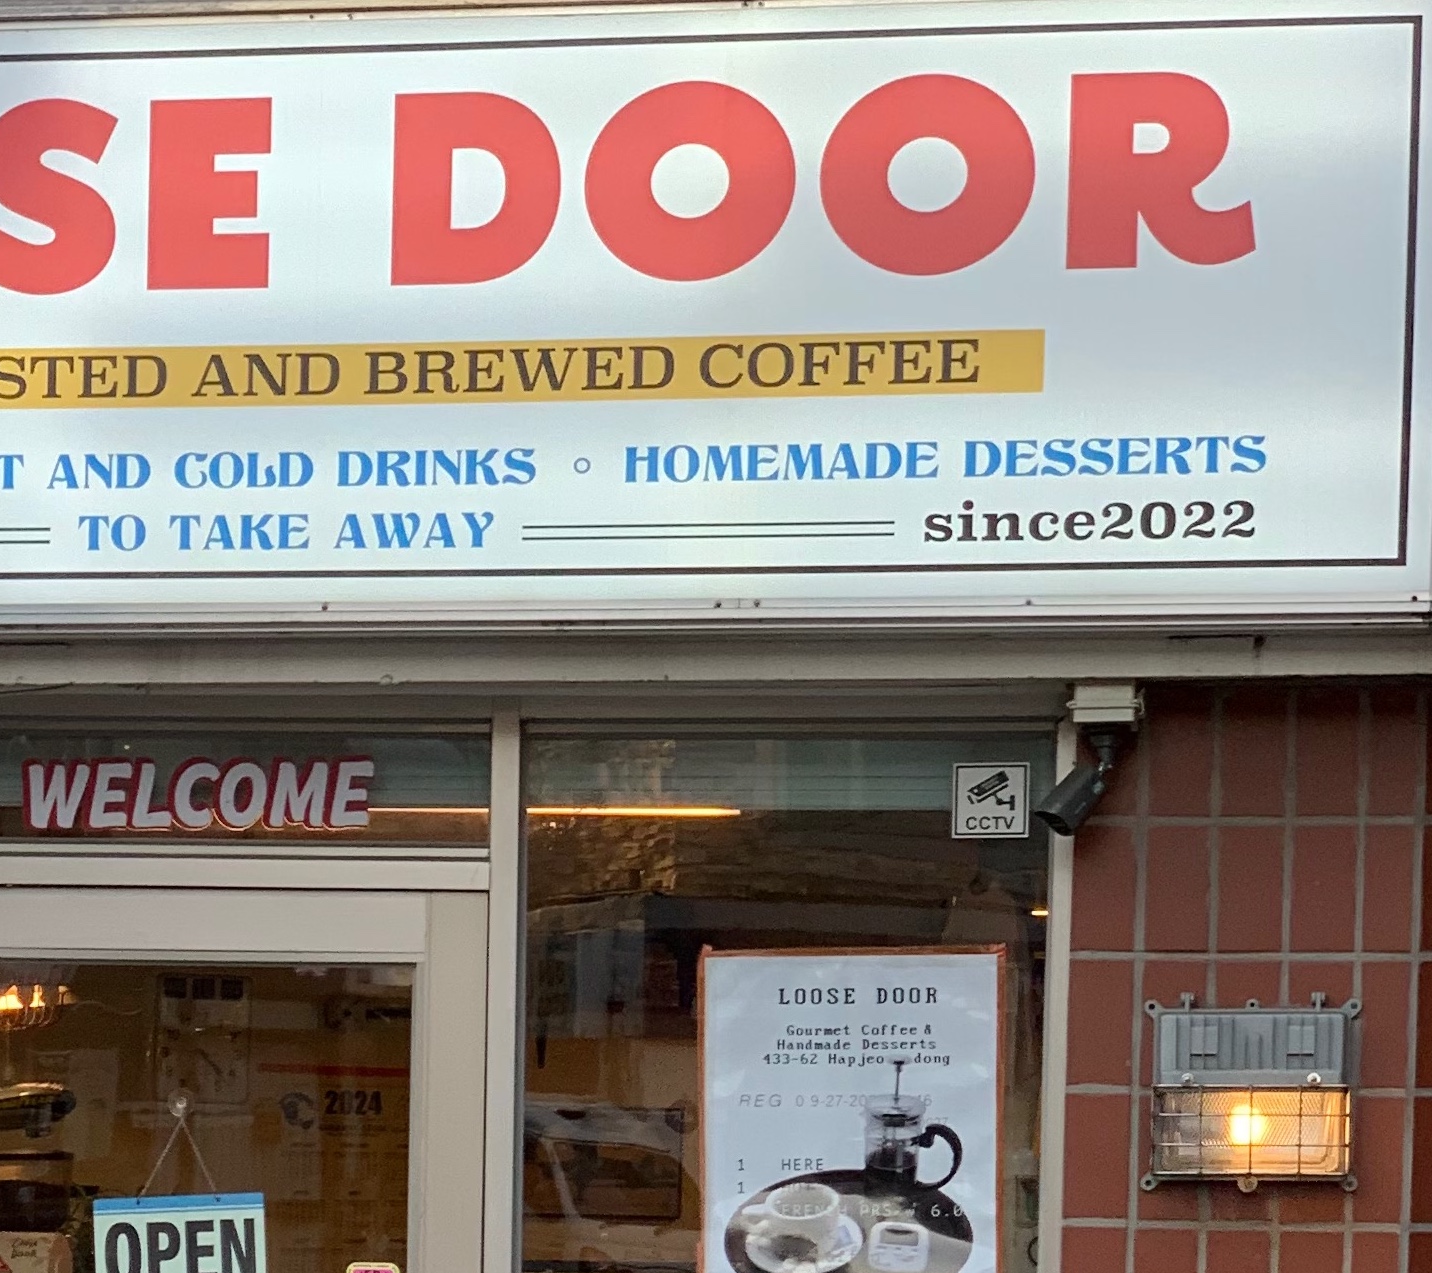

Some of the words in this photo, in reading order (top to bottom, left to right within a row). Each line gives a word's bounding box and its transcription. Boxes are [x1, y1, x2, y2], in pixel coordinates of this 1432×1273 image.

[390, 71, 1256, 286] DOOR
[191, 351, 341, 397] AND
[364, 345, 675, 394] BREWED
[698, 338, 981, 388] COFFEE
[46, 452, 151, 490] AND
[174, 450, 314, 489] COLD
[336, 447, 537, 487] DRINKS
[623, 441, 939, 484] HOMEMADE
[963, 434, 1268, 478] DESSERTS
[923, 499, 1257, 542] since2022
[77, 514, 147, 553] TO
[169, 512, 310, 551] TAKE
[334, 510, 495, 550] AWAY
[23, 757, 374, 831] WELCOME
[965, 816, 1015, 830] CCTV
[778, 988, 856, 1005] LOOSE
[876, 987, 939, 1004] DOOR
[786, 1025, 850, 1036] Gourmet
[861, 1024, 917, 1036] Coffee
[777, 1039, 851, 1050] Handmade
[862, 1038, 937, 1050] Desserts
[763, 1053, 818, 1065] 433-62
[739, 1094, 782, 1107] REG
[737, 1159, 745, 1171] 1
[781, 1158, 824, 1171] HERE
[737, 1182, 745, 1194] 1
